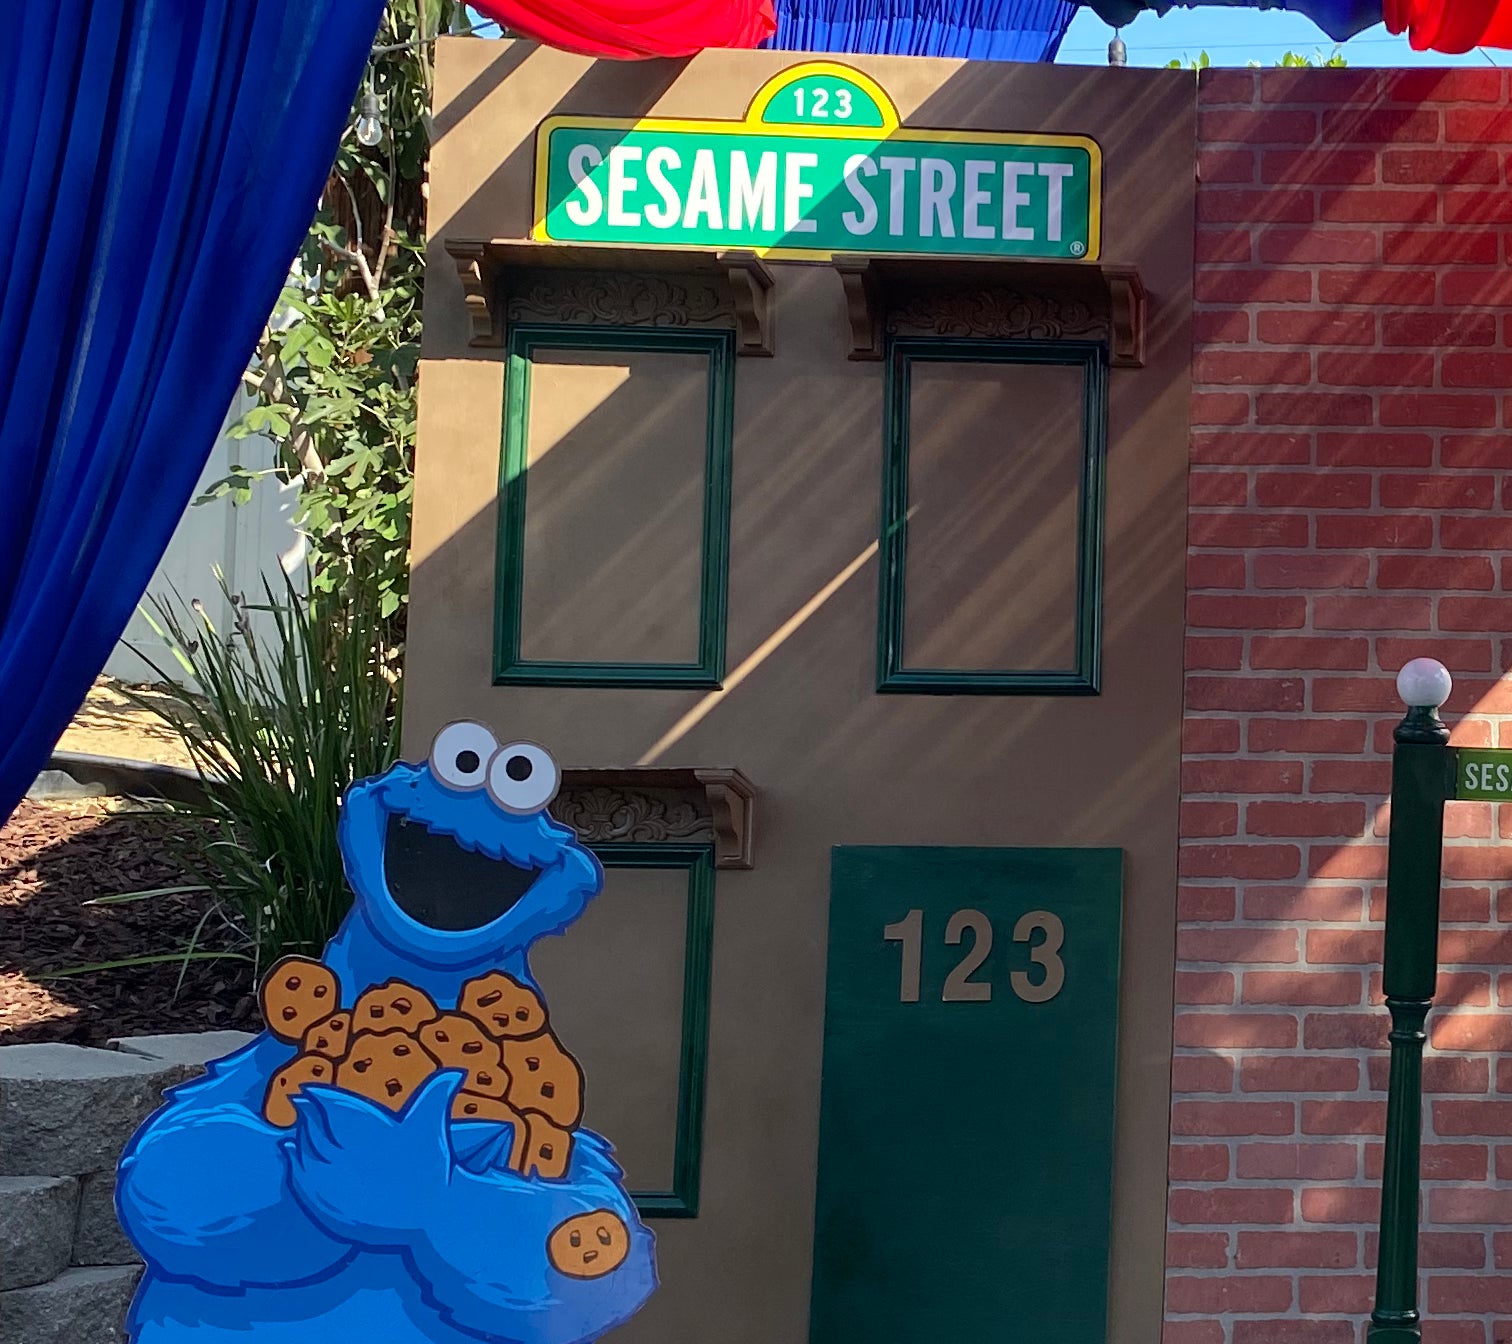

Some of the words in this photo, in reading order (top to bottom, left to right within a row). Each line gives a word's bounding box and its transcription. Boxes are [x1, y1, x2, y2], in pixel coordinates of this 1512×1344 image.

[794, 86, 852, 119] 123
[565, 143, 818, 233] SESAME
[842, 154, 1073, 242] STREET
[884, 909, 1065, 1002] 123
